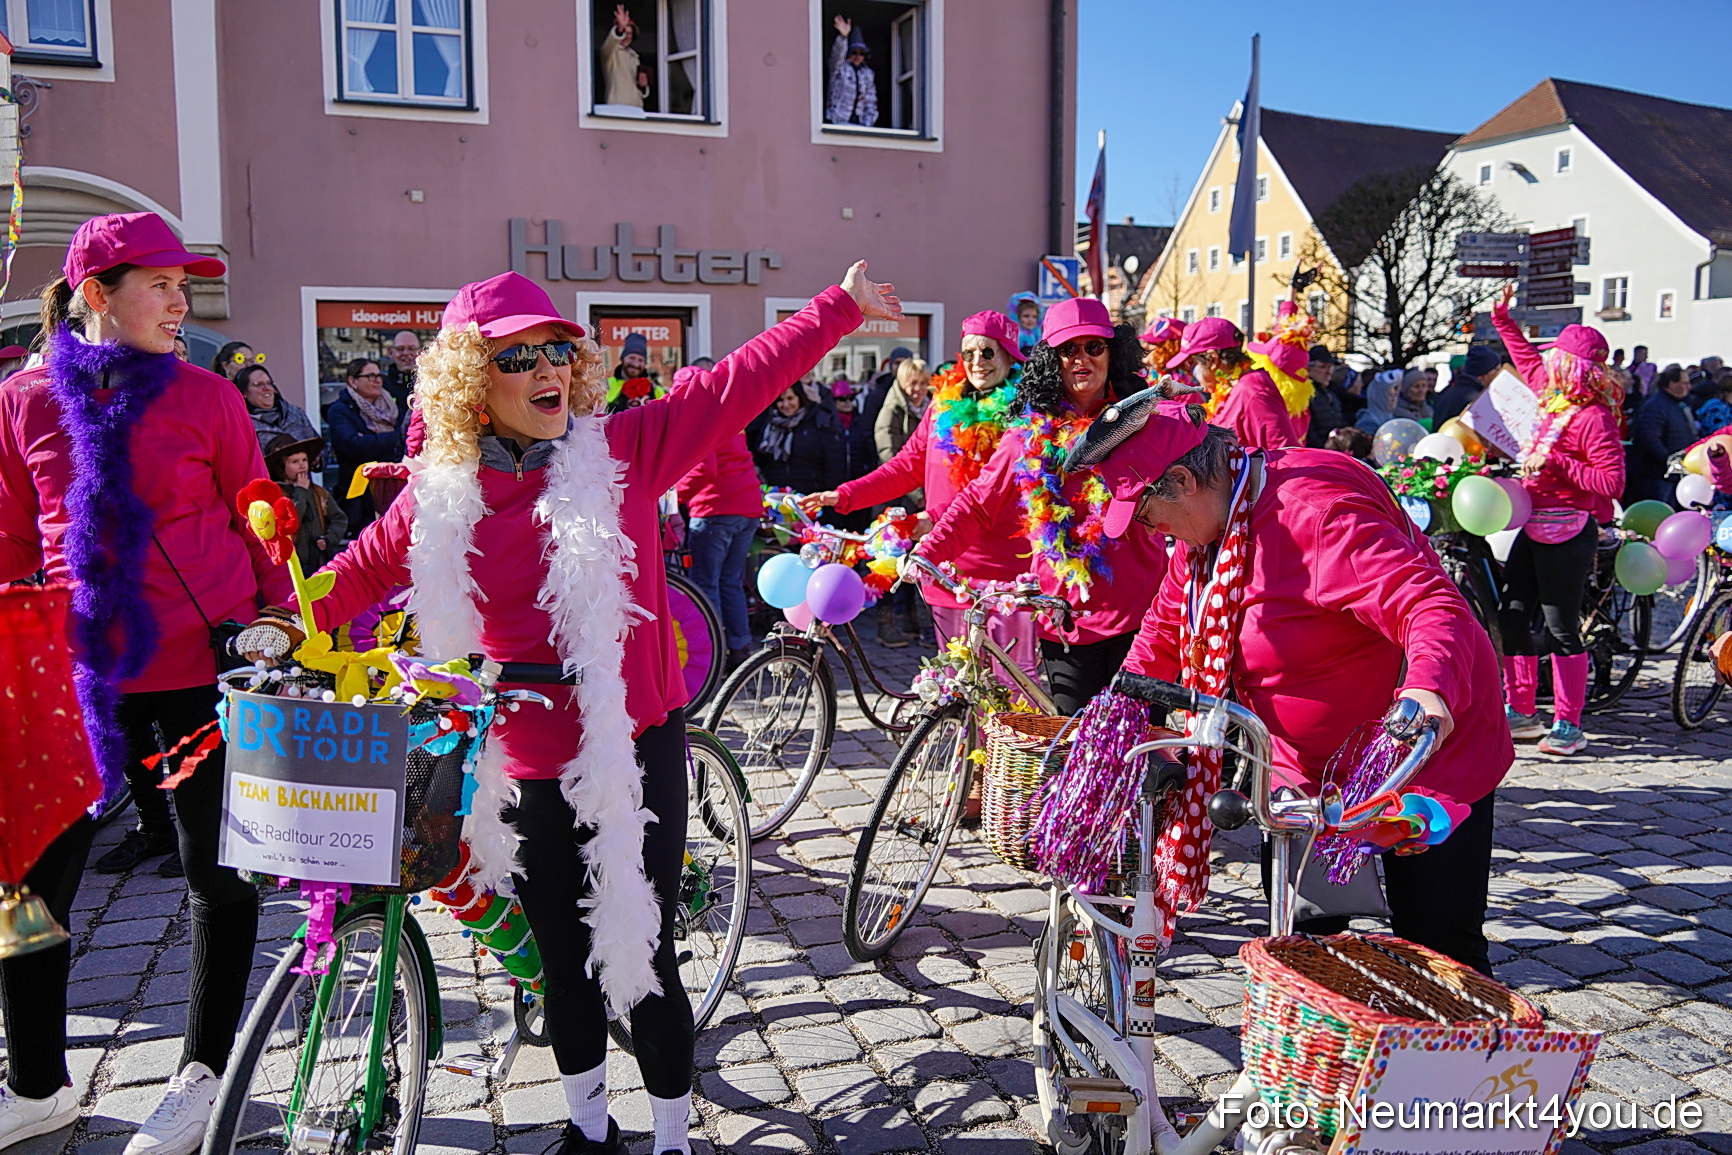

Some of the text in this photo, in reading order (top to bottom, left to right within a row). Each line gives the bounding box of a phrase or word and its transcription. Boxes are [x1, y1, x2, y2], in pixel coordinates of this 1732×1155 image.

[509, 217, 782, 285] Hutter
[612, 325, 670, 341] HUTTER
[1719, 527, 1732, 541] B
[238, 699, 287, 758] BR
[293, 707, 390, 737] RADL
[292, 735, 389, 764] TOUR
[238, 780, 270, 802] TEAM
[241, 819, 374, 850] BR-Radltour 2025
